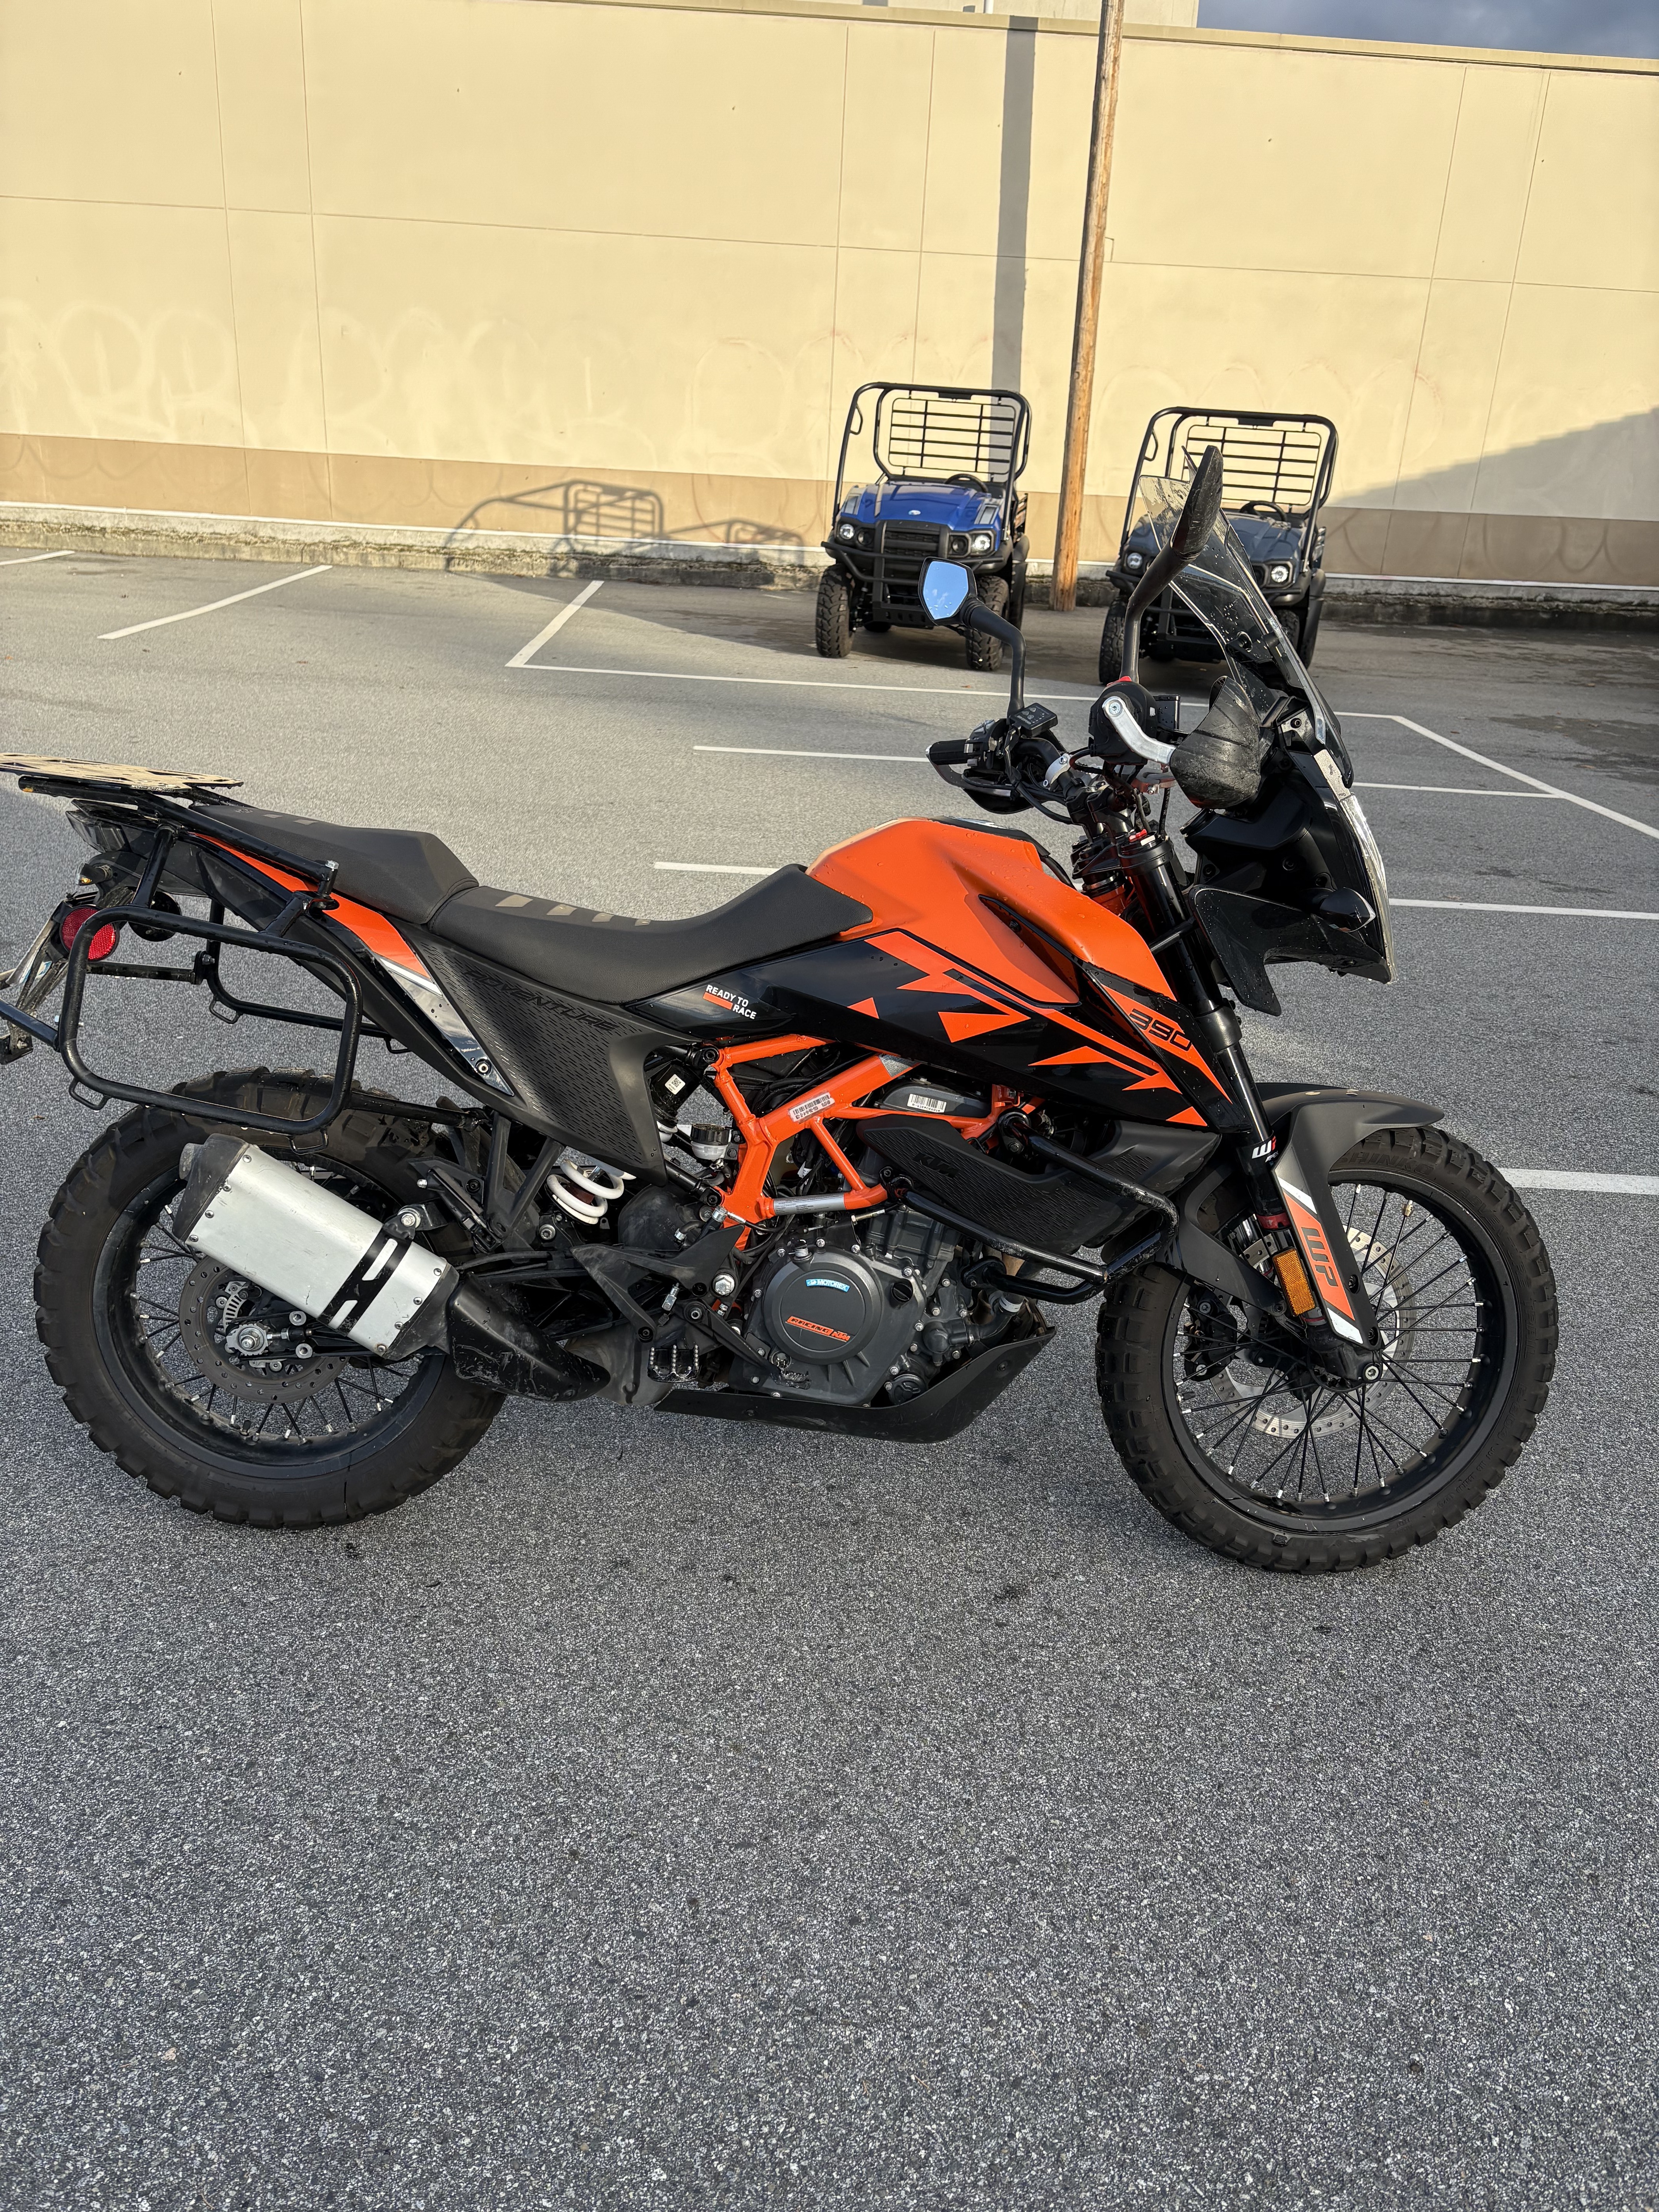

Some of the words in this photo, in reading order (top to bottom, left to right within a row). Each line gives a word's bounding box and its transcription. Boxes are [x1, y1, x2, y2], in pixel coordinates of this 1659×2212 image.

[464, 970, 619, 1032] ADVENTURE
[706, 984, 737, 1001] READY
[737, 996, 749, 1007] TO
[732, 1004, 757, 1020] RACE
[1128, 1008, 1192, 1052] 390
[912, 1152, 959, 1179] KTM
[1265, 1151, 1279, 1163] APEX
[1301, 1227, 1339, 1287] WP
[791, 1318, 829, 1333] RACING
[831, 1331, 851, 1341] KTM
